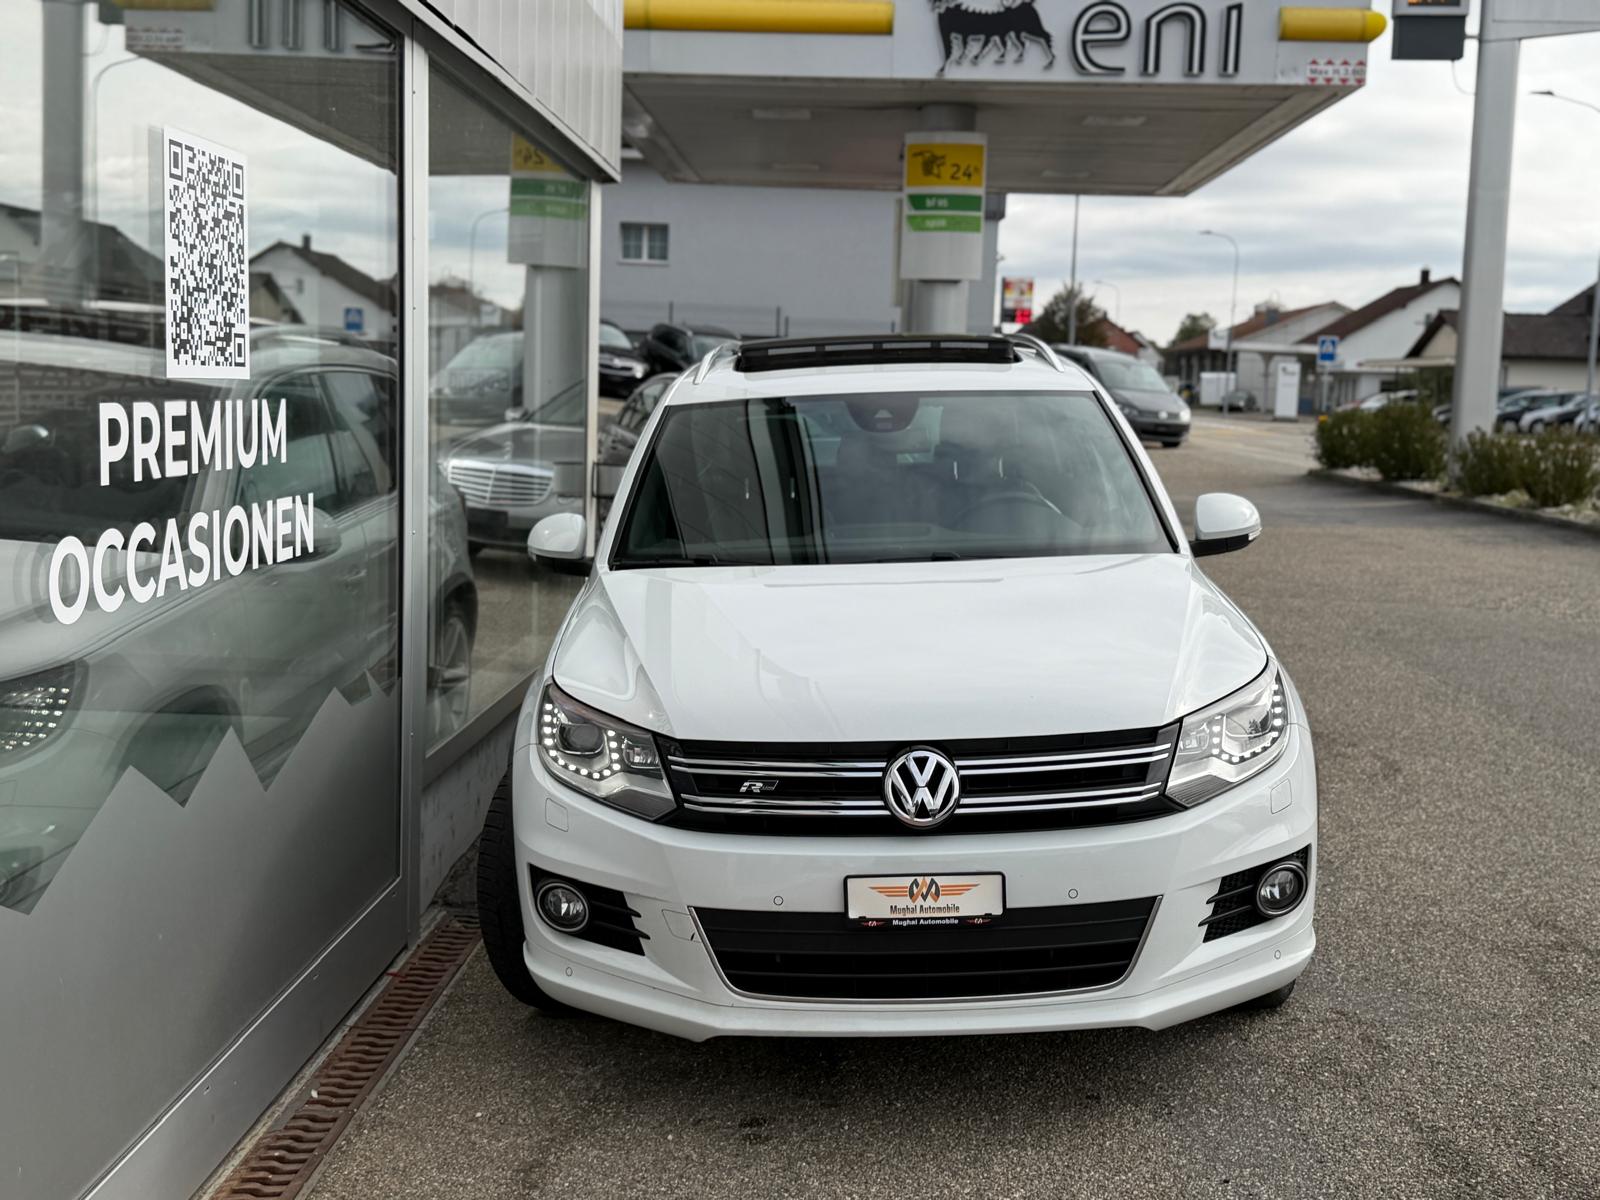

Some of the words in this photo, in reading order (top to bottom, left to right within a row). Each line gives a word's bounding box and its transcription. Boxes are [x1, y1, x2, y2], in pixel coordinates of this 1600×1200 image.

[1072, 0, 1243, 75] eni
[99, 398, 287, 486] PREMIUM
[50, 493, 314, 625] OCCASIONEN
[890, 905, 917, 916] Mughal
[919, 904, 960, 914] Automobile
[892, 919, 917, 927] Mughal
